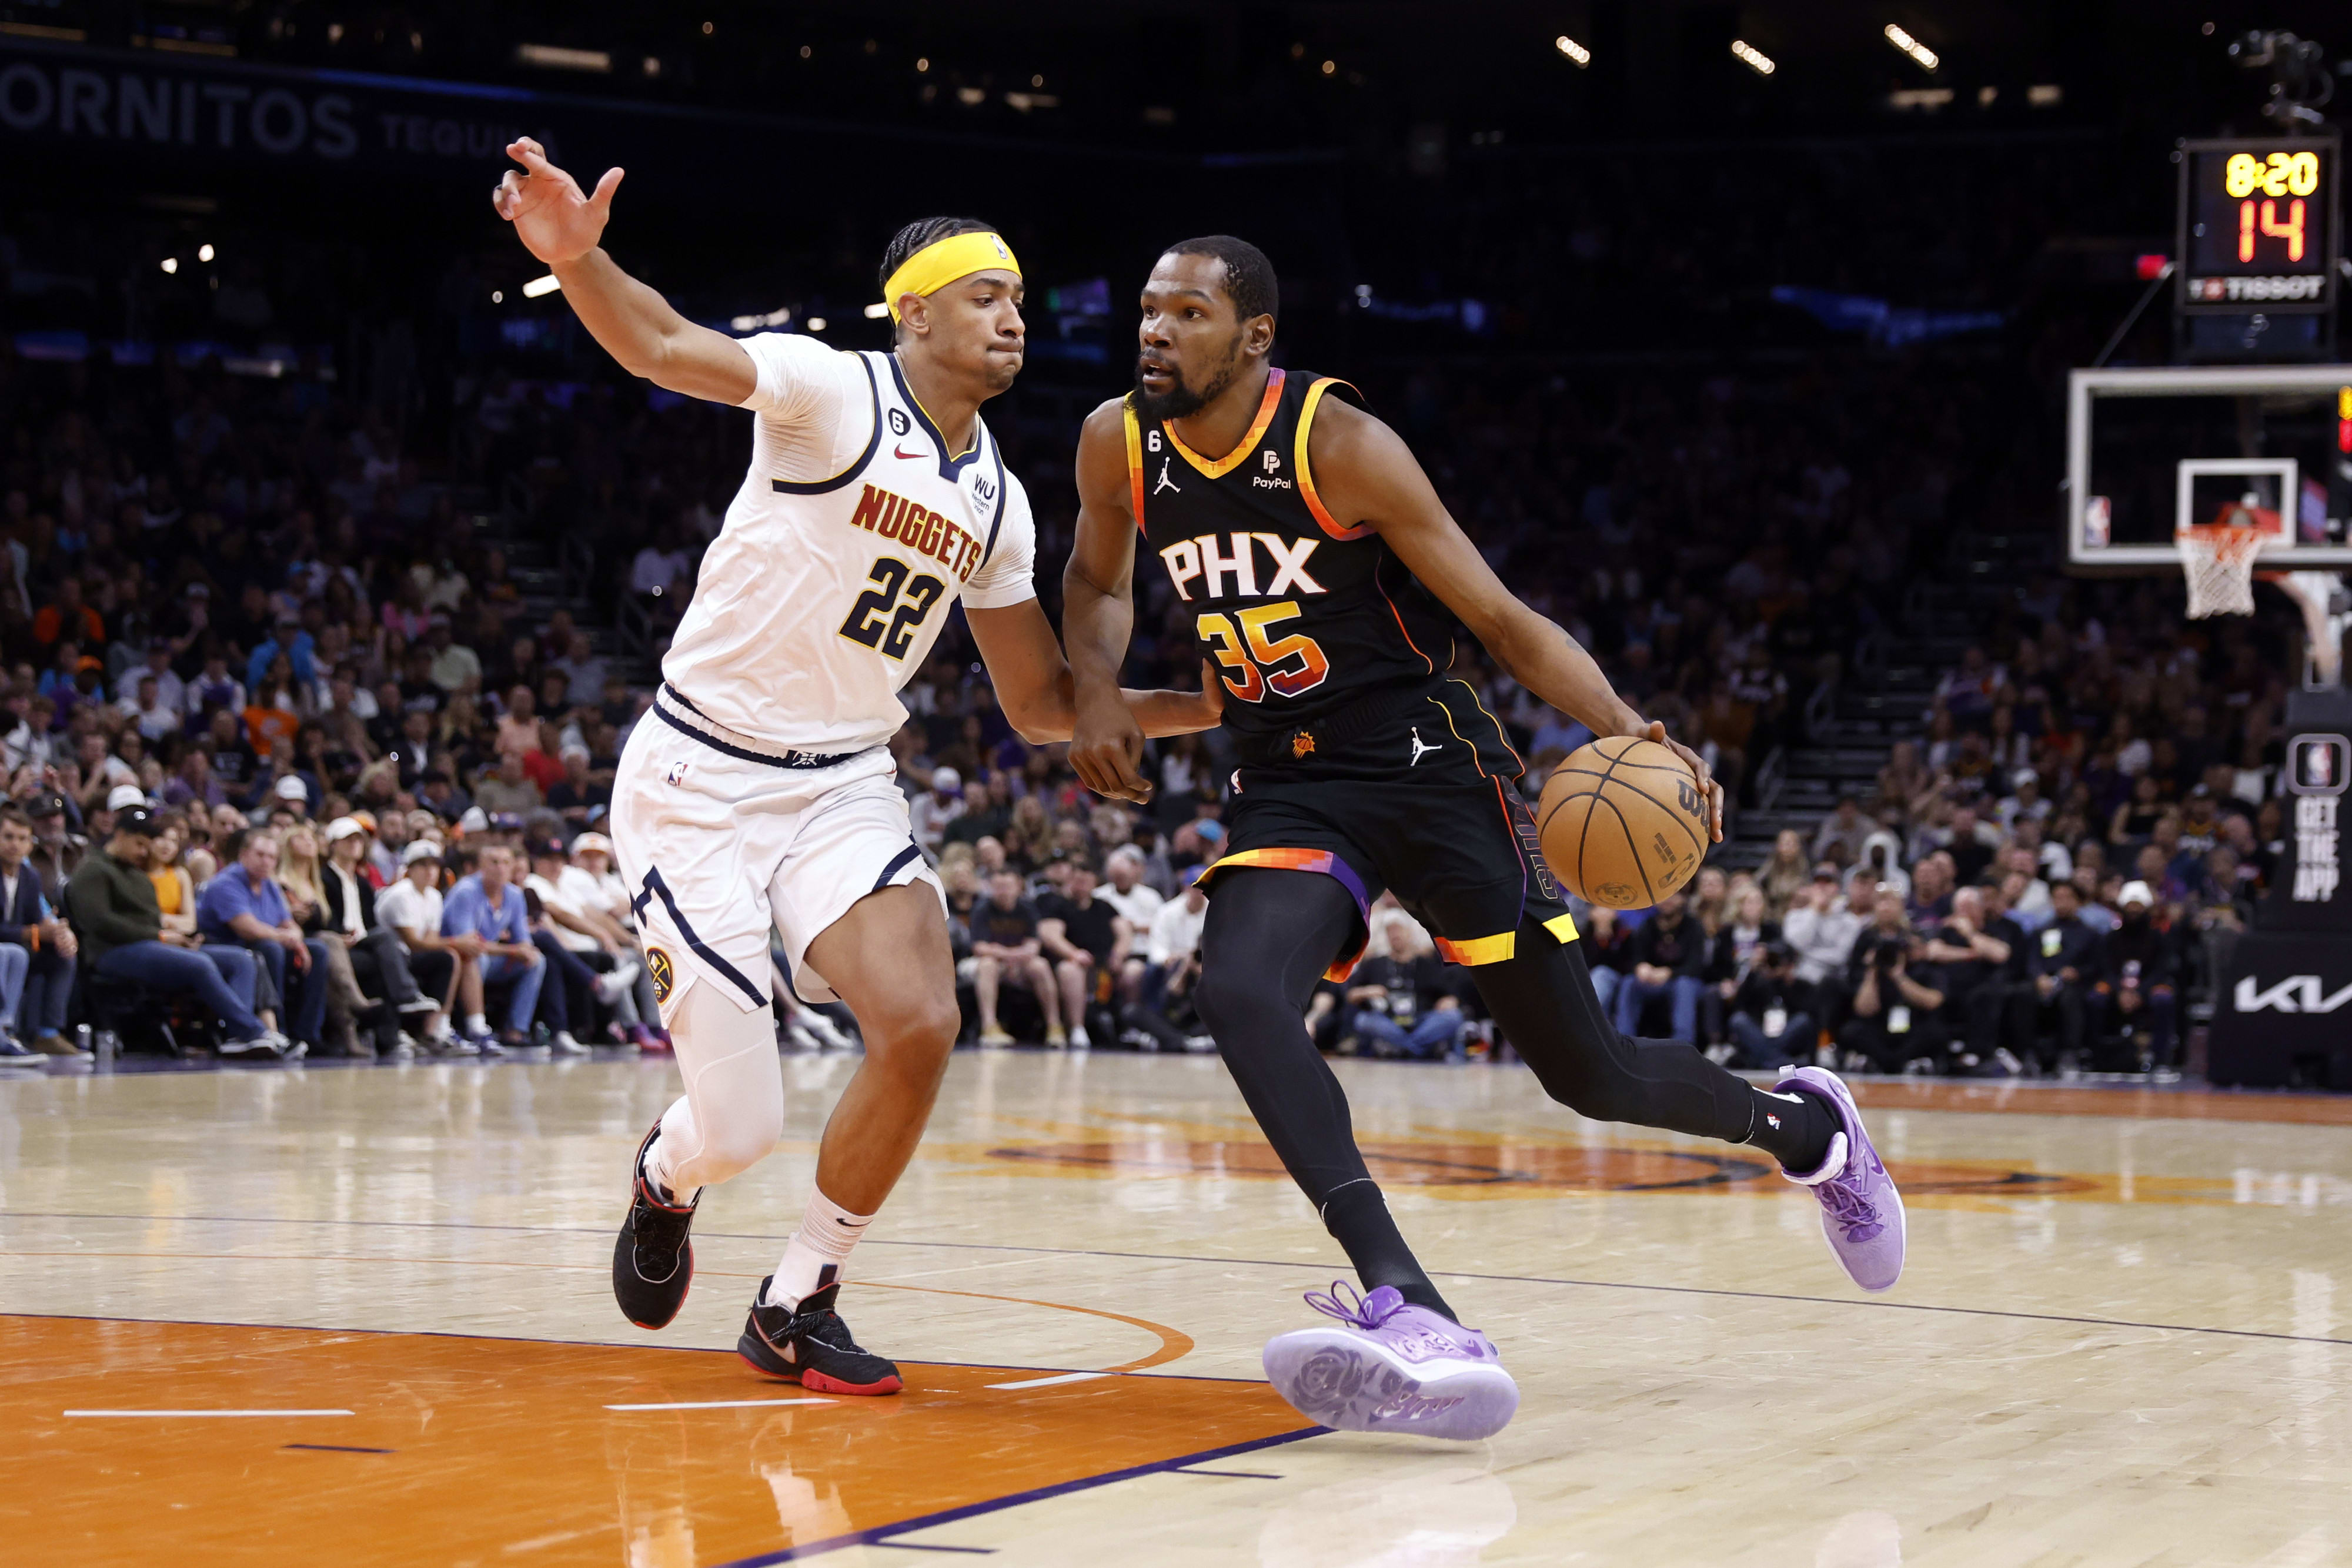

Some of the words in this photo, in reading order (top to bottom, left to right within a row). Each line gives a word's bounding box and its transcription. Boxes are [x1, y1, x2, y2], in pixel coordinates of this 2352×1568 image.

[0, 61, 360, 161] ORNITOS
[2226, 152, 2318, 198] 8:20
[2239, 199, 2306, 262] 14
[892, 412, 904, 433] 6
[1148, 430, 1161, 452] 6
[971, 491, 990, 510] Western
[974, 474, 995, 500] WU
[1253, 477, 1291, 489] PayPal
[849, 483, 982, 583] NUGGETS
[1159, 531, 1329, 600] PHX
[836, 556, 948, 663] 22
[1197, 600, 1329, 703] 35
